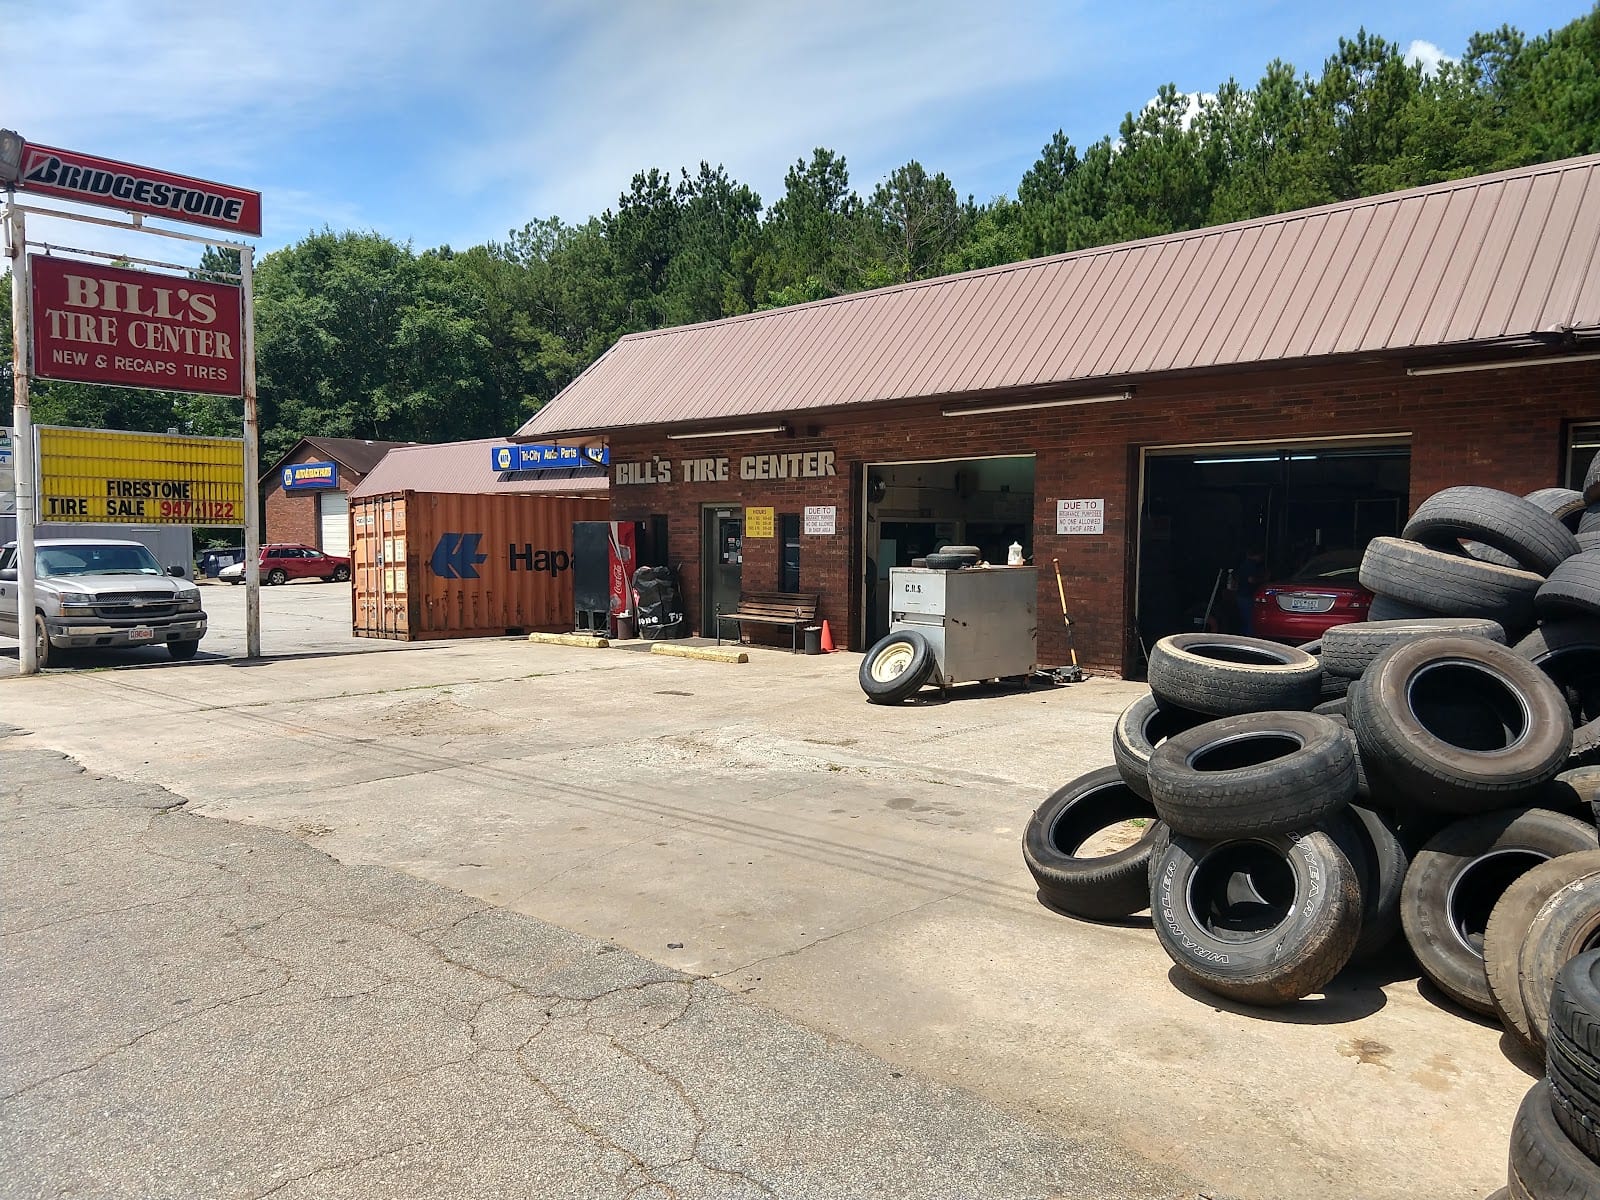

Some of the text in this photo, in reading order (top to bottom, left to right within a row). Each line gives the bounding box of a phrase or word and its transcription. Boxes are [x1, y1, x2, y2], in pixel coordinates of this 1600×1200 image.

[25, 152, 245, 223] BRIDGESTONE
[63, 274, 217, 324] BILL'S
[45, 308, 234, 360] TIRE CENTER
[53, 349, 228, 381] NEW & RECAPS TIRES
[560, 448, 576, 458] Parts
[615, 451, 836, 485] BILL'S TIRE CENTER
[107, 480, 190, 498] FIRESTONE
[1063, 501, 1097, 509] DUE TO
[49, 498, 88, 515] TIRE
[107, 500, 145, 516] SALE
[509, 544, 574, 578] Hap
[1161, 860, 1230, 964] WRANGLER
